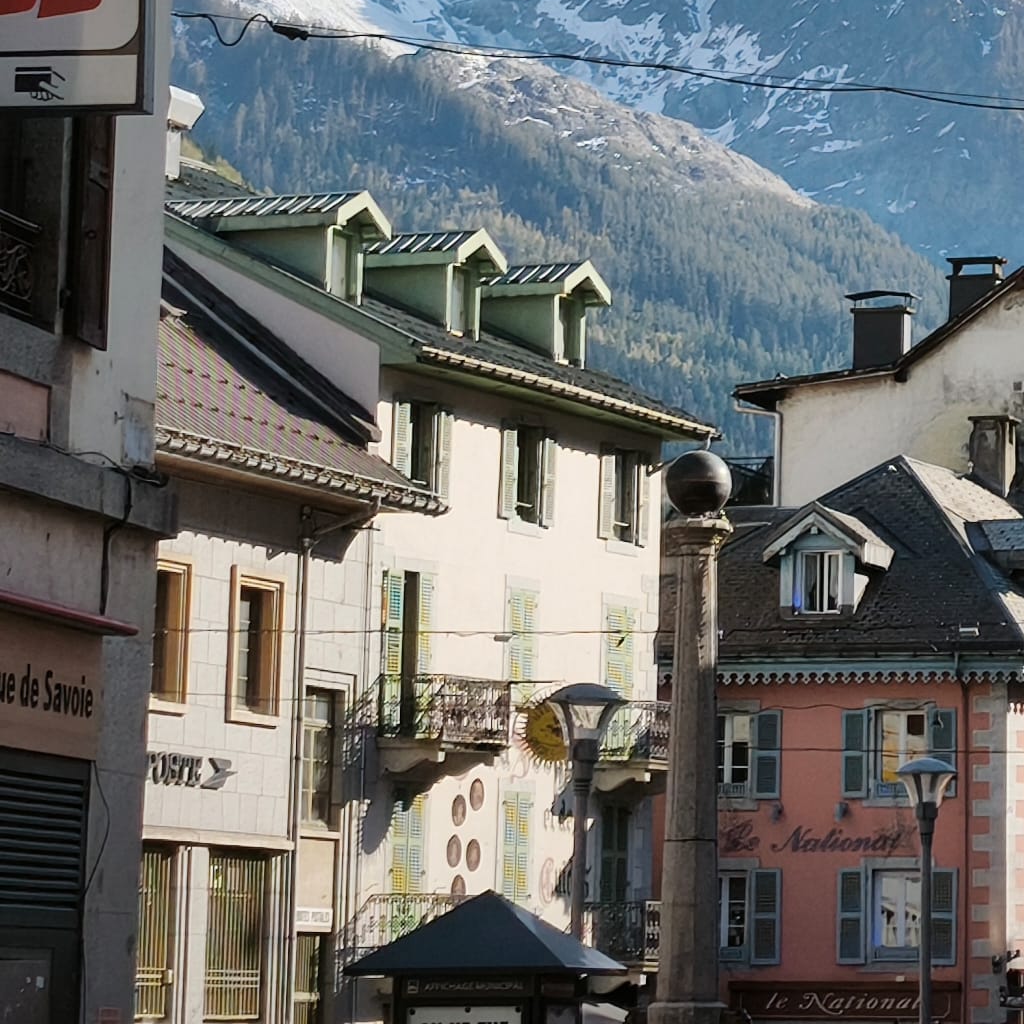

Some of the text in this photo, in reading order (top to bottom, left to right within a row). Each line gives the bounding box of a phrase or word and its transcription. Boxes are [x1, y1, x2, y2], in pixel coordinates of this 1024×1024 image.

[20, 663, 39, 709] de
[43, 669, 93, 718] Savoie
[771, 825, 905, 853] National
[766, 992, 921, 1015] le National
